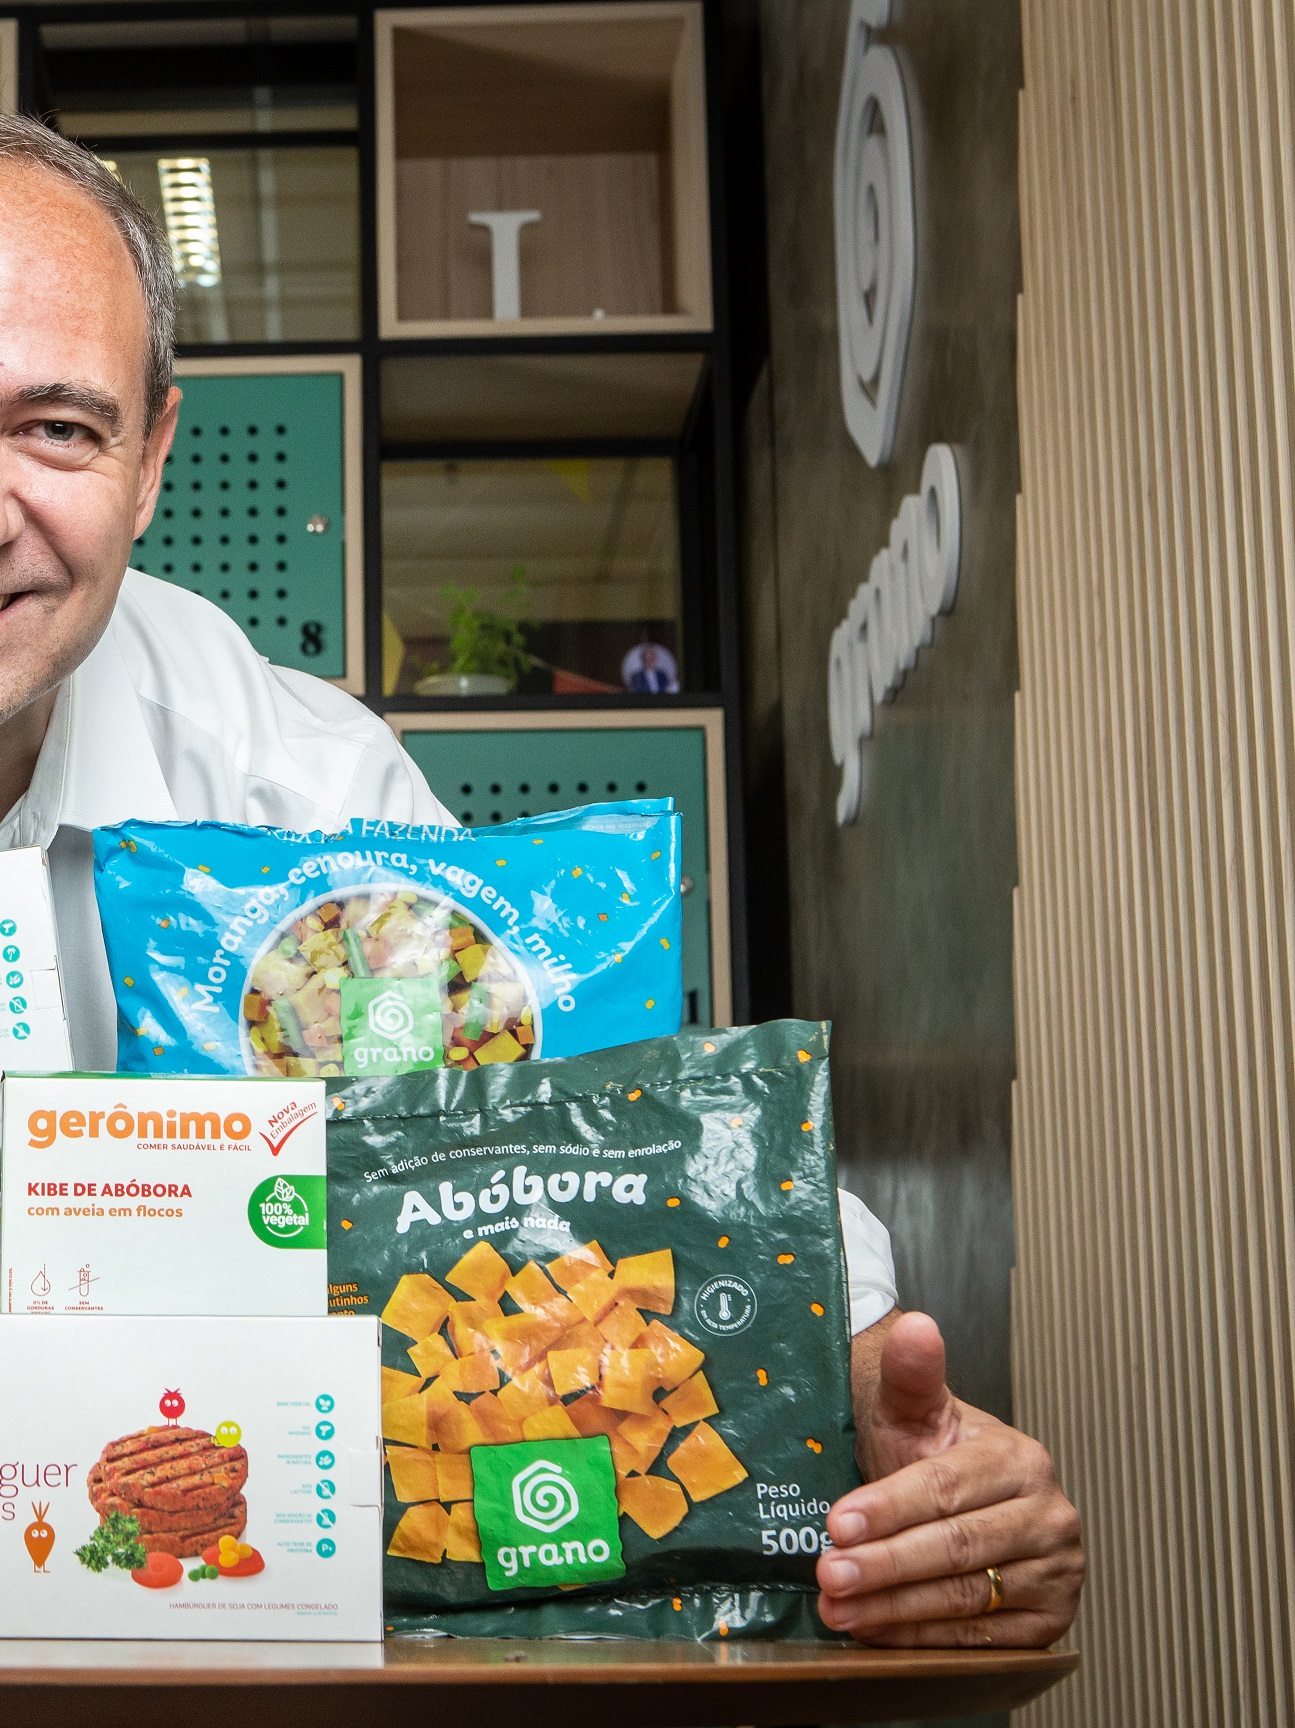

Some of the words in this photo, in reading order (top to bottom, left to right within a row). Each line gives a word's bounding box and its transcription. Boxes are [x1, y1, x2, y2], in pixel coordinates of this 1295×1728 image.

[301, 621, 323, 656] 8
[288, 850, 418, 886] cenoura,
[428, 859, 520, 935] vagem,
[524, 932, 578, 1012] milho
[354, 1043, 435, 1070] grano
[27, 1102, 252, 1149] gerônimo
[267, 1101, 298, 1128] Nova
[270, 1102, 318, 1140] Embalagem
[137, 1143, 169, 1151] COMER
[171, 1141, 217, 1152] SAUDÁVEL
[219, 1142, 225, 1151] É
[228, 1142, 252, 1152] FÁCIL
[363, 1167, 389, 1183] Sem
[390, 1156, 429, 1174] adição
[431, 1151, 447, 1163] de
[449, 1143, 530, 1160] conservantes,
[532, 1144, 557, 1154] sem
[559, 1143, 589, 1156] sódio
[592, 1149, 601, 1157] e
[602, 1149, 625, 1159] sem
[628, 1139, 682, 1158] enrolação
[27, 1182, 69, 1197] KIBE
[73, 1182, 97, 1197] DE
[100, 1179, 193, 1198] ABÓBORA
[396, 1165, 648, 1234] Abóbora
[27, 1206, 61, 1217] com
[63, 1204, 106, 1217] aveia
[108, 1207, 134, 1218] em
[136, 1204, 183, 1218] flocos
[259, 1202, 294, 1216] 100%
[262, 1212, 310, 1228] vegetal
[463, 1229, 474, 1239] e
[477, 1216, 520, 1237] mais
[523, 1216, 571, 1233] nada
[329, 1294, 369, 1307] utinhos
[700, 1280, 749, 1301] HIGIENIZADO
[756, 1483, 801, 1500] Peso
[758, 1498, 831, 1521] Líquido
[498, 1539, 610, 1577] grano
